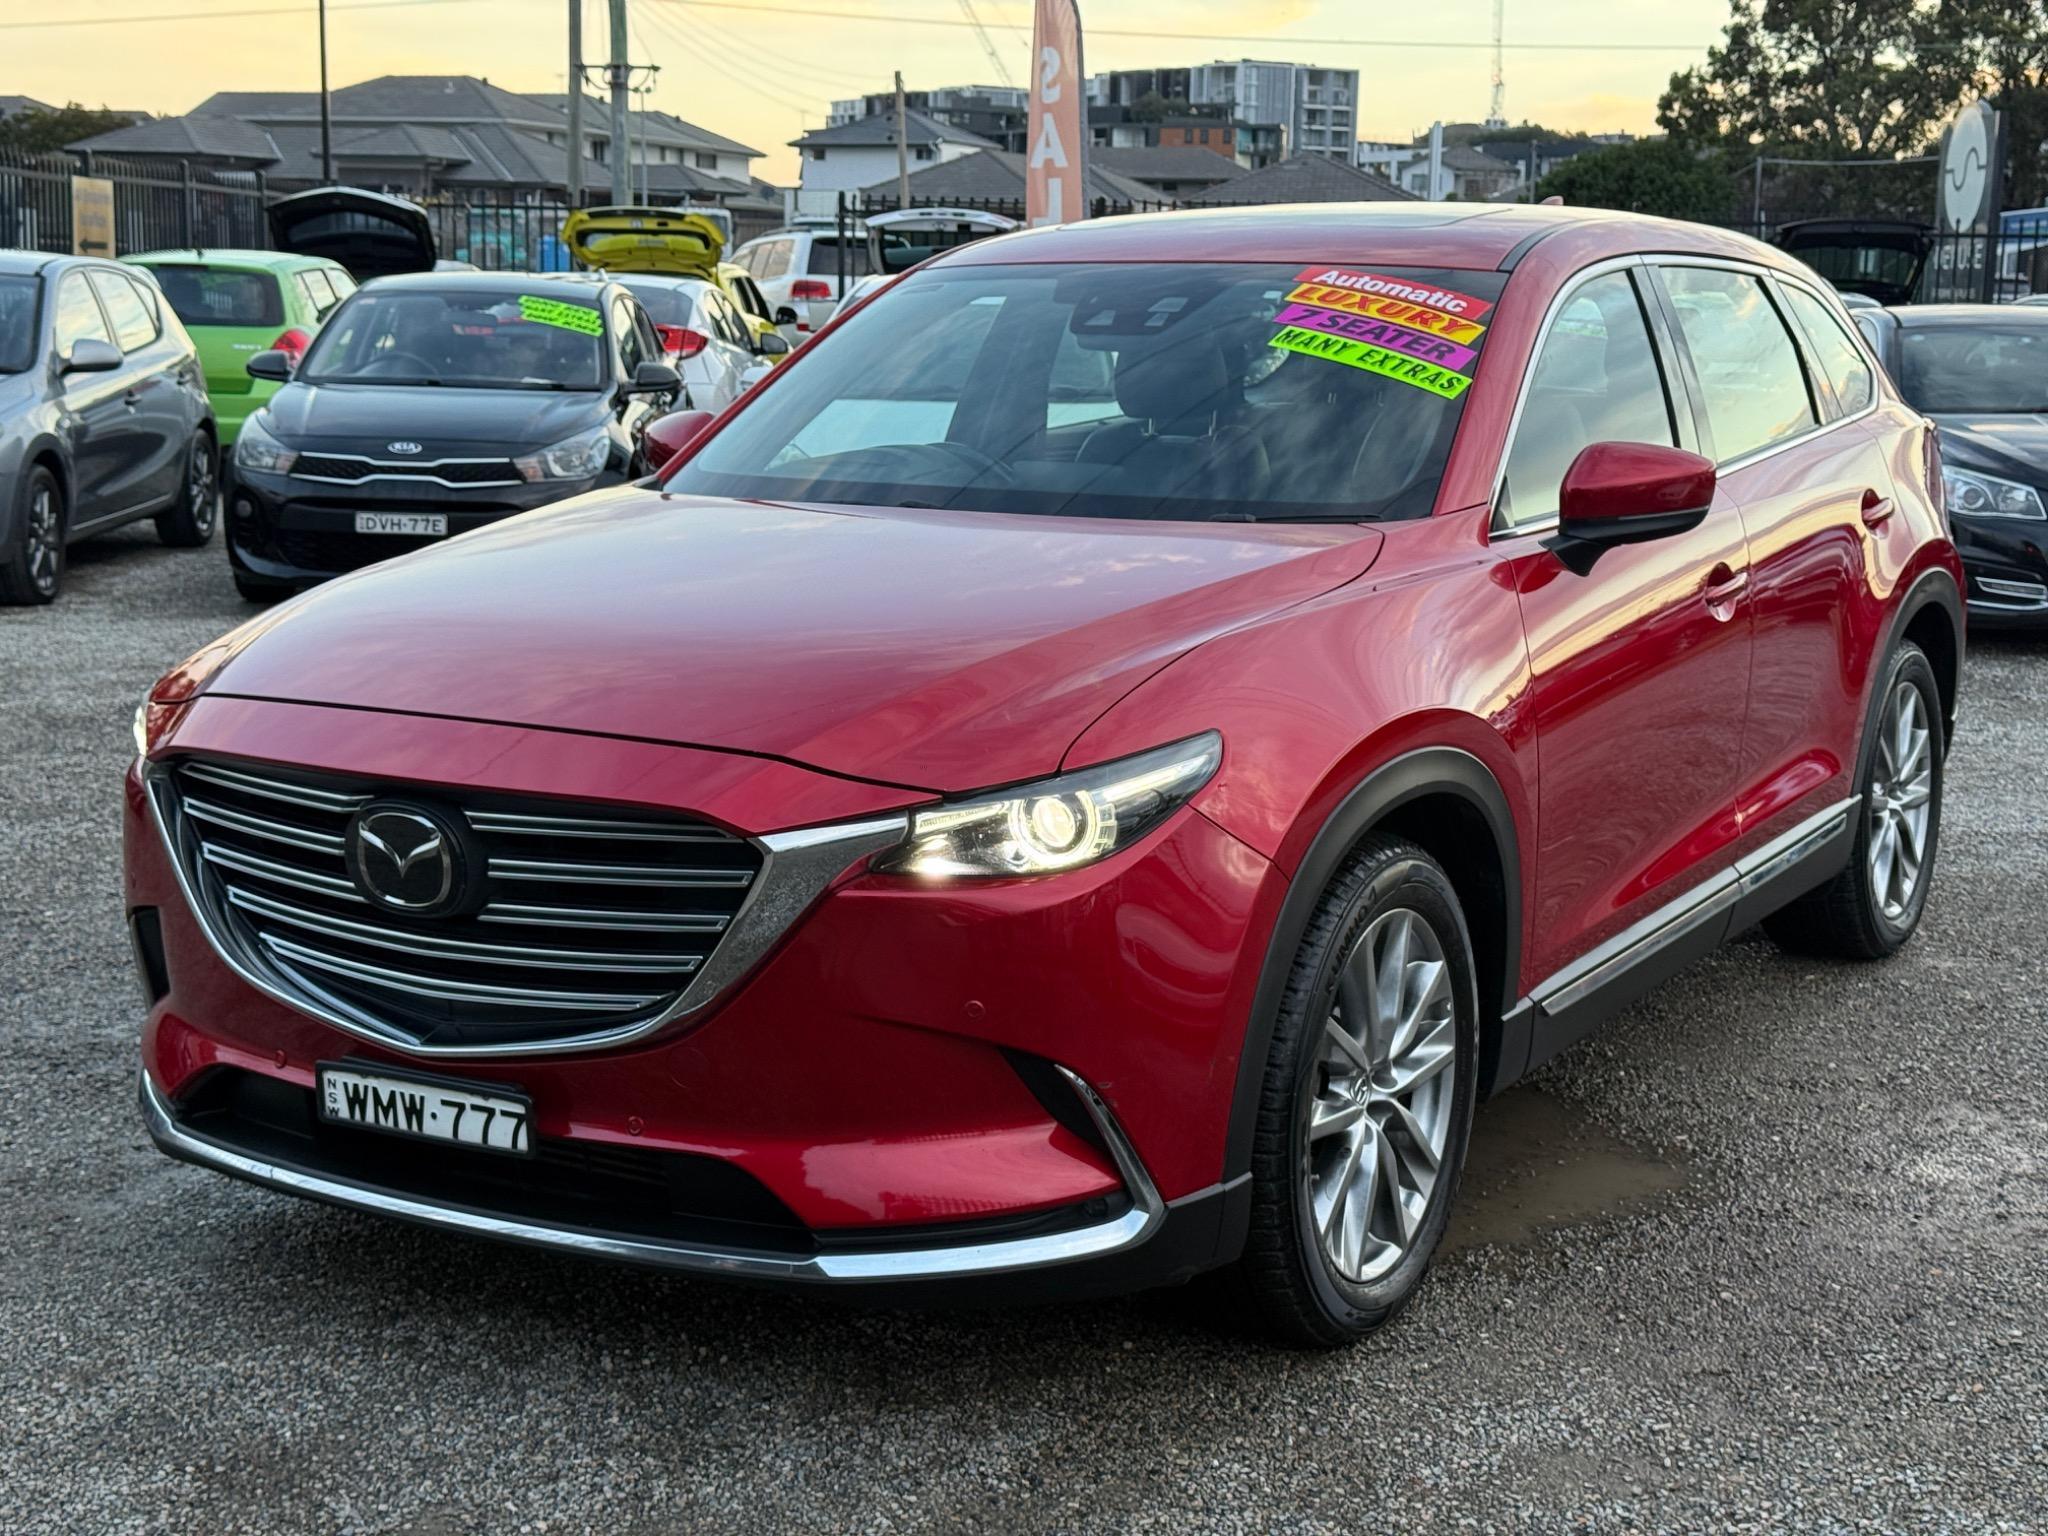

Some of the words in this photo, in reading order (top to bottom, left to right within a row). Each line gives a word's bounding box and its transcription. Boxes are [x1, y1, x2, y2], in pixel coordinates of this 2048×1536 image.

[1294, 286, 1474, 335] LUXURY
[1312, 270, 1468, 313] Automatic
[1288, 308, 1320, 323] 7
[1316, 314, 1456, 362] SEATER
[1276, 329, 1357, 355] MANY
[1356, 348, 1464, 391] EXTRAS
[327, 1077, 340, 1118] NSW
